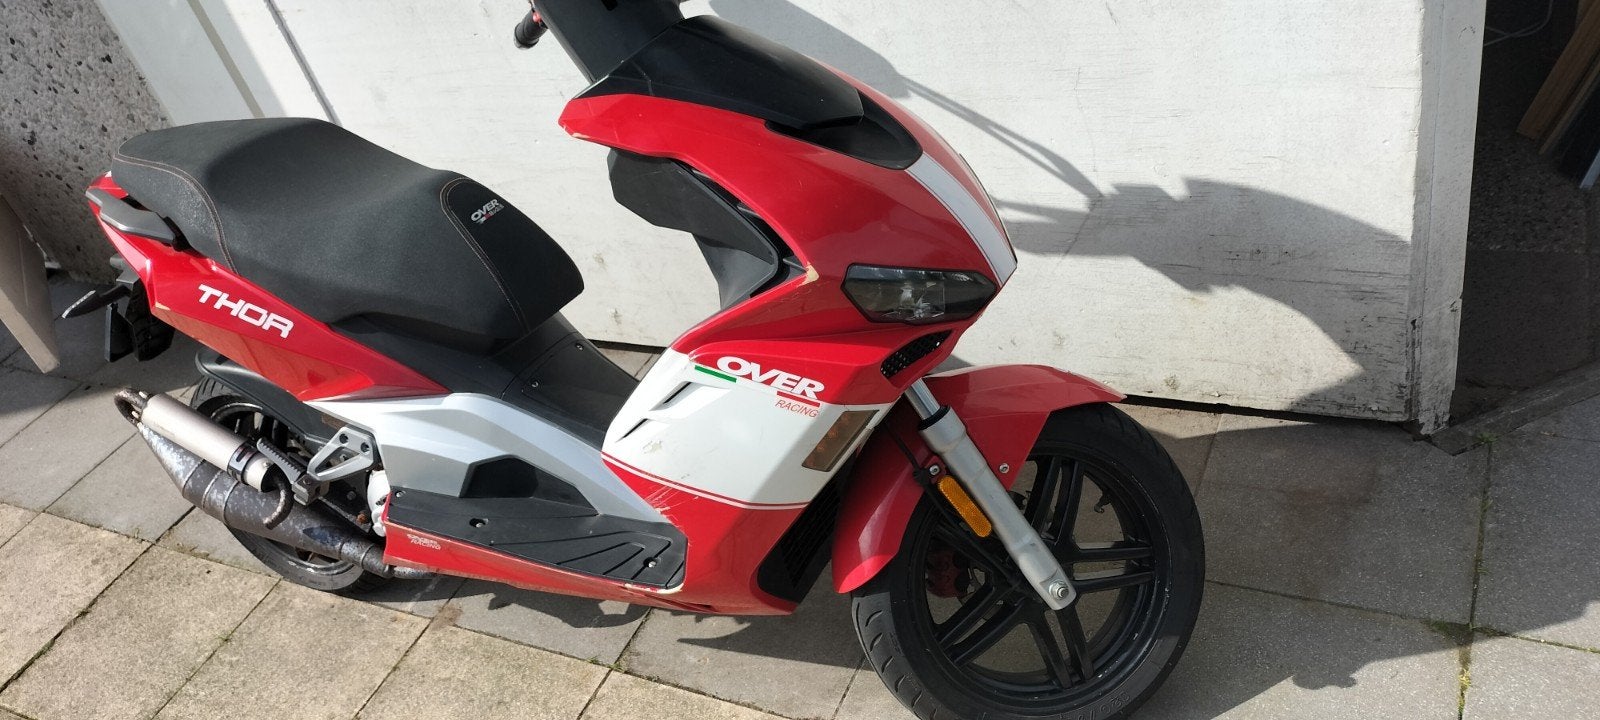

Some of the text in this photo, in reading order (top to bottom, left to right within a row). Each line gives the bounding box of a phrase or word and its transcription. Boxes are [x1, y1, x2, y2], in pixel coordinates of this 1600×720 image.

[471, 199, 499, 221] OVER
[198, 284, 294, 338] THOR
[717, 356, 825, 400] OVER
[775, 399, 819, 418] RACING
